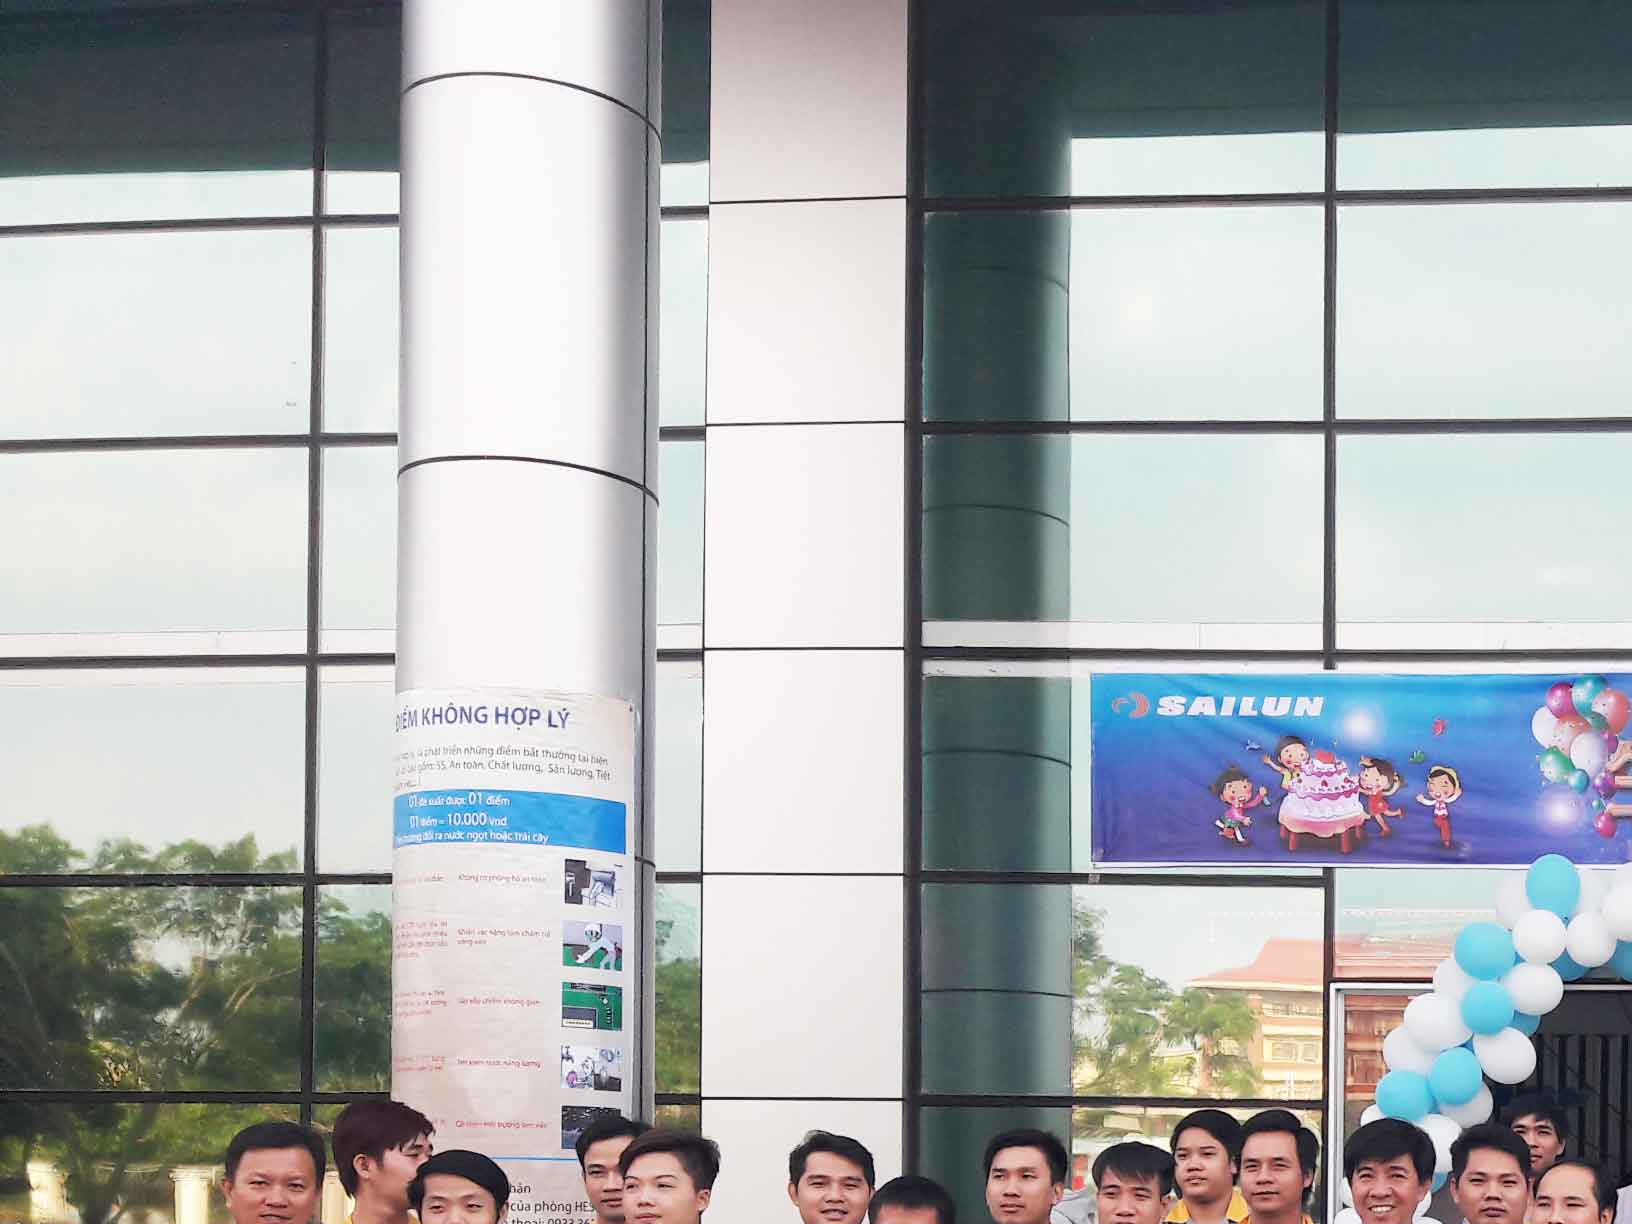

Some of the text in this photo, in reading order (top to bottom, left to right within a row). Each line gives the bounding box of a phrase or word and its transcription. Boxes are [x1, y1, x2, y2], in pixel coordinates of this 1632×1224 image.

[1156, 695, 1325, 717] SAILUN
[421, 701, 488, 725] KHÔNG
[495, 705, 541, 731] HỢP
[547, 707, 570, 729] LÝ
[468, 791, 482, 805] 01
[447, 812, 487, 826] 10.000
[510, 1200, 531, 1212] của
[534, 1200, 572, 1215] phòng
